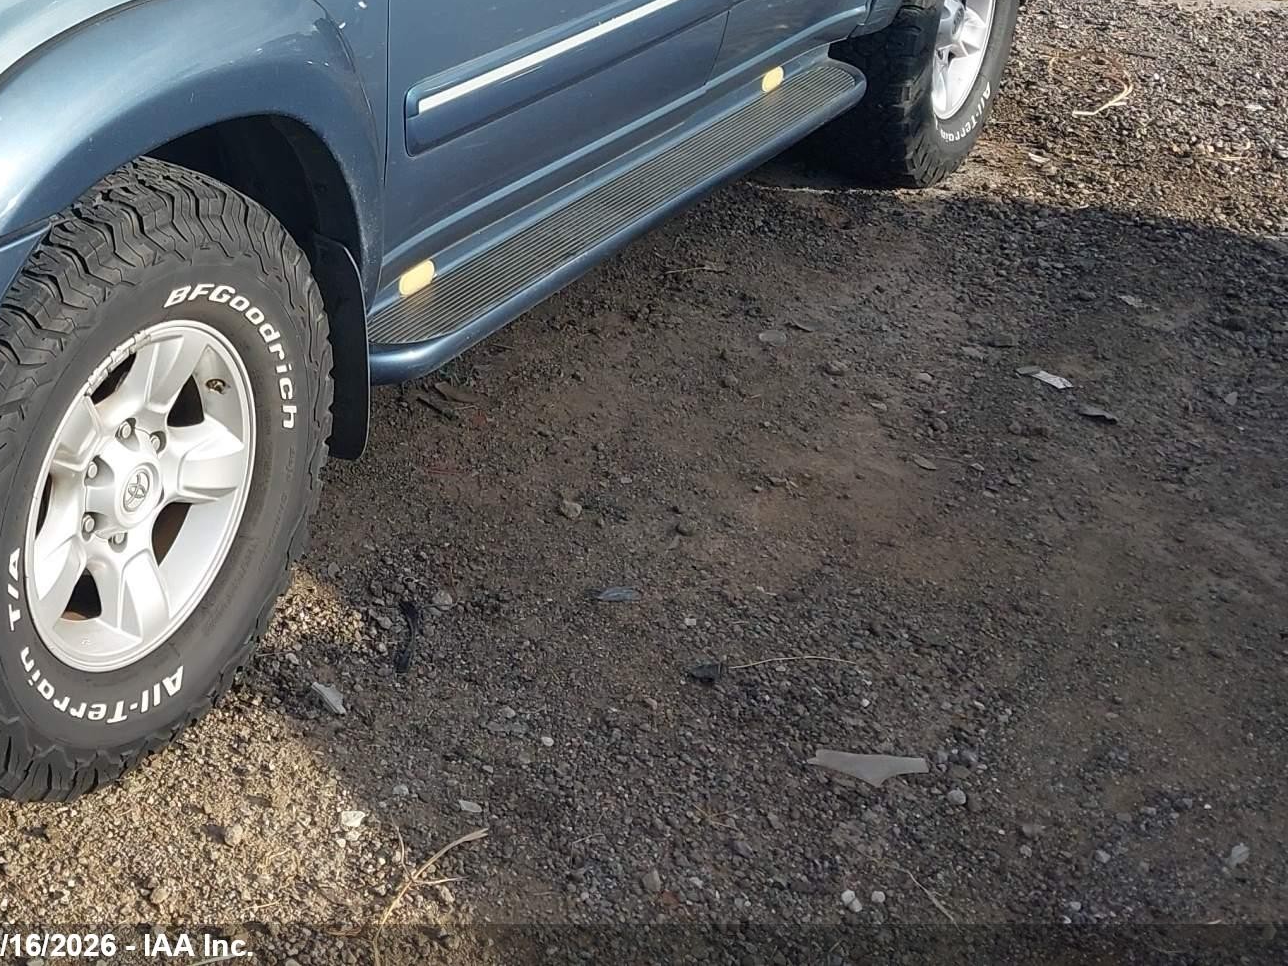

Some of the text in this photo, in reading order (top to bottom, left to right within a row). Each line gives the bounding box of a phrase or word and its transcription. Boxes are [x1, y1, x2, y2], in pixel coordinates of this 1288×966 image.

[163, 283, 298, 429] BFGoodrich
[8, 547, 184, 724] All-Terrain T/A
